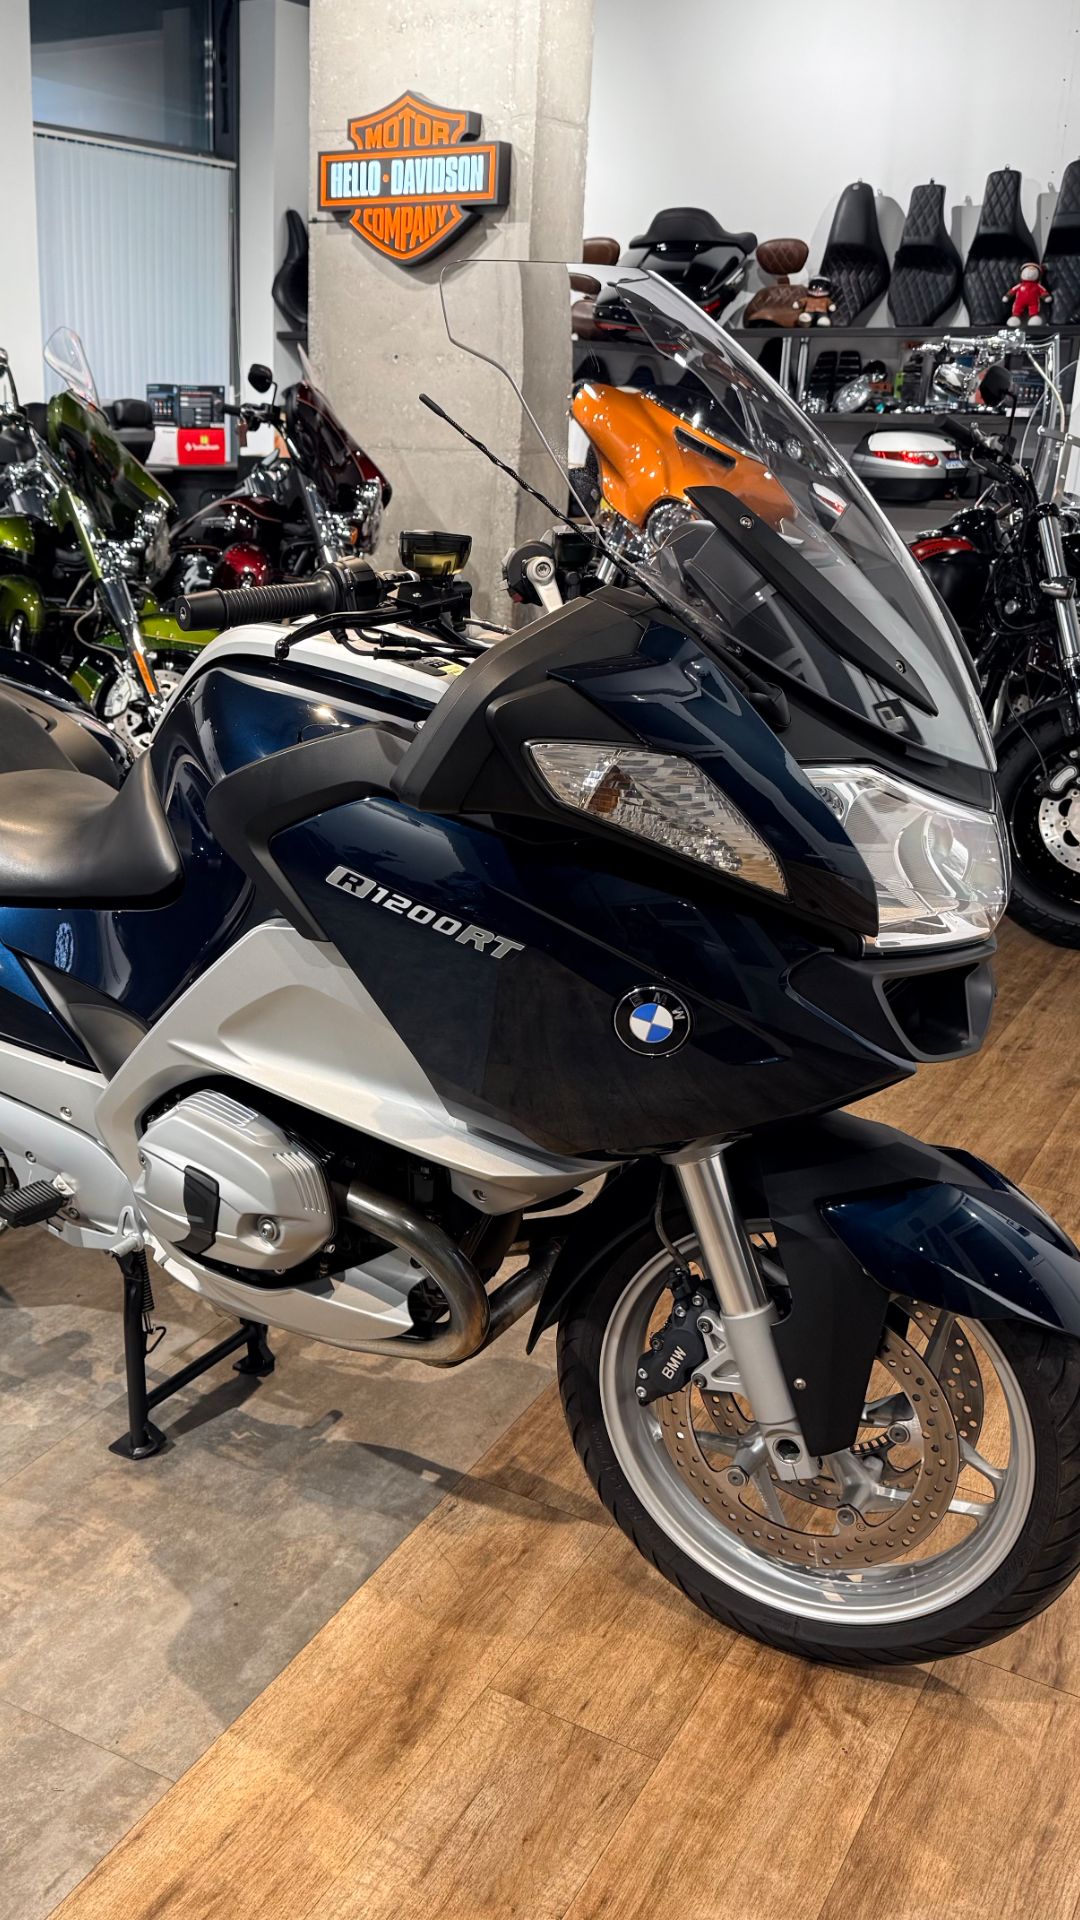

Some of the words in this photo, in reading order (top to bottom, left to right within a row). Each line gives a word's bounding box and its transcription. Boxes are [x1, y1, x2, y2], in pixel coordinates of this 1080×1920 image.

[365, 107, 450, 150] MOTOR
[330, 160, 381, 198] HELLO
[390, 154, 485, 196] DAVIDSON
[363, 204, 449, 252] COMPANY
[629, 991, 687, 1021] BMW
[661, 1345, 687, 1380] BMW
